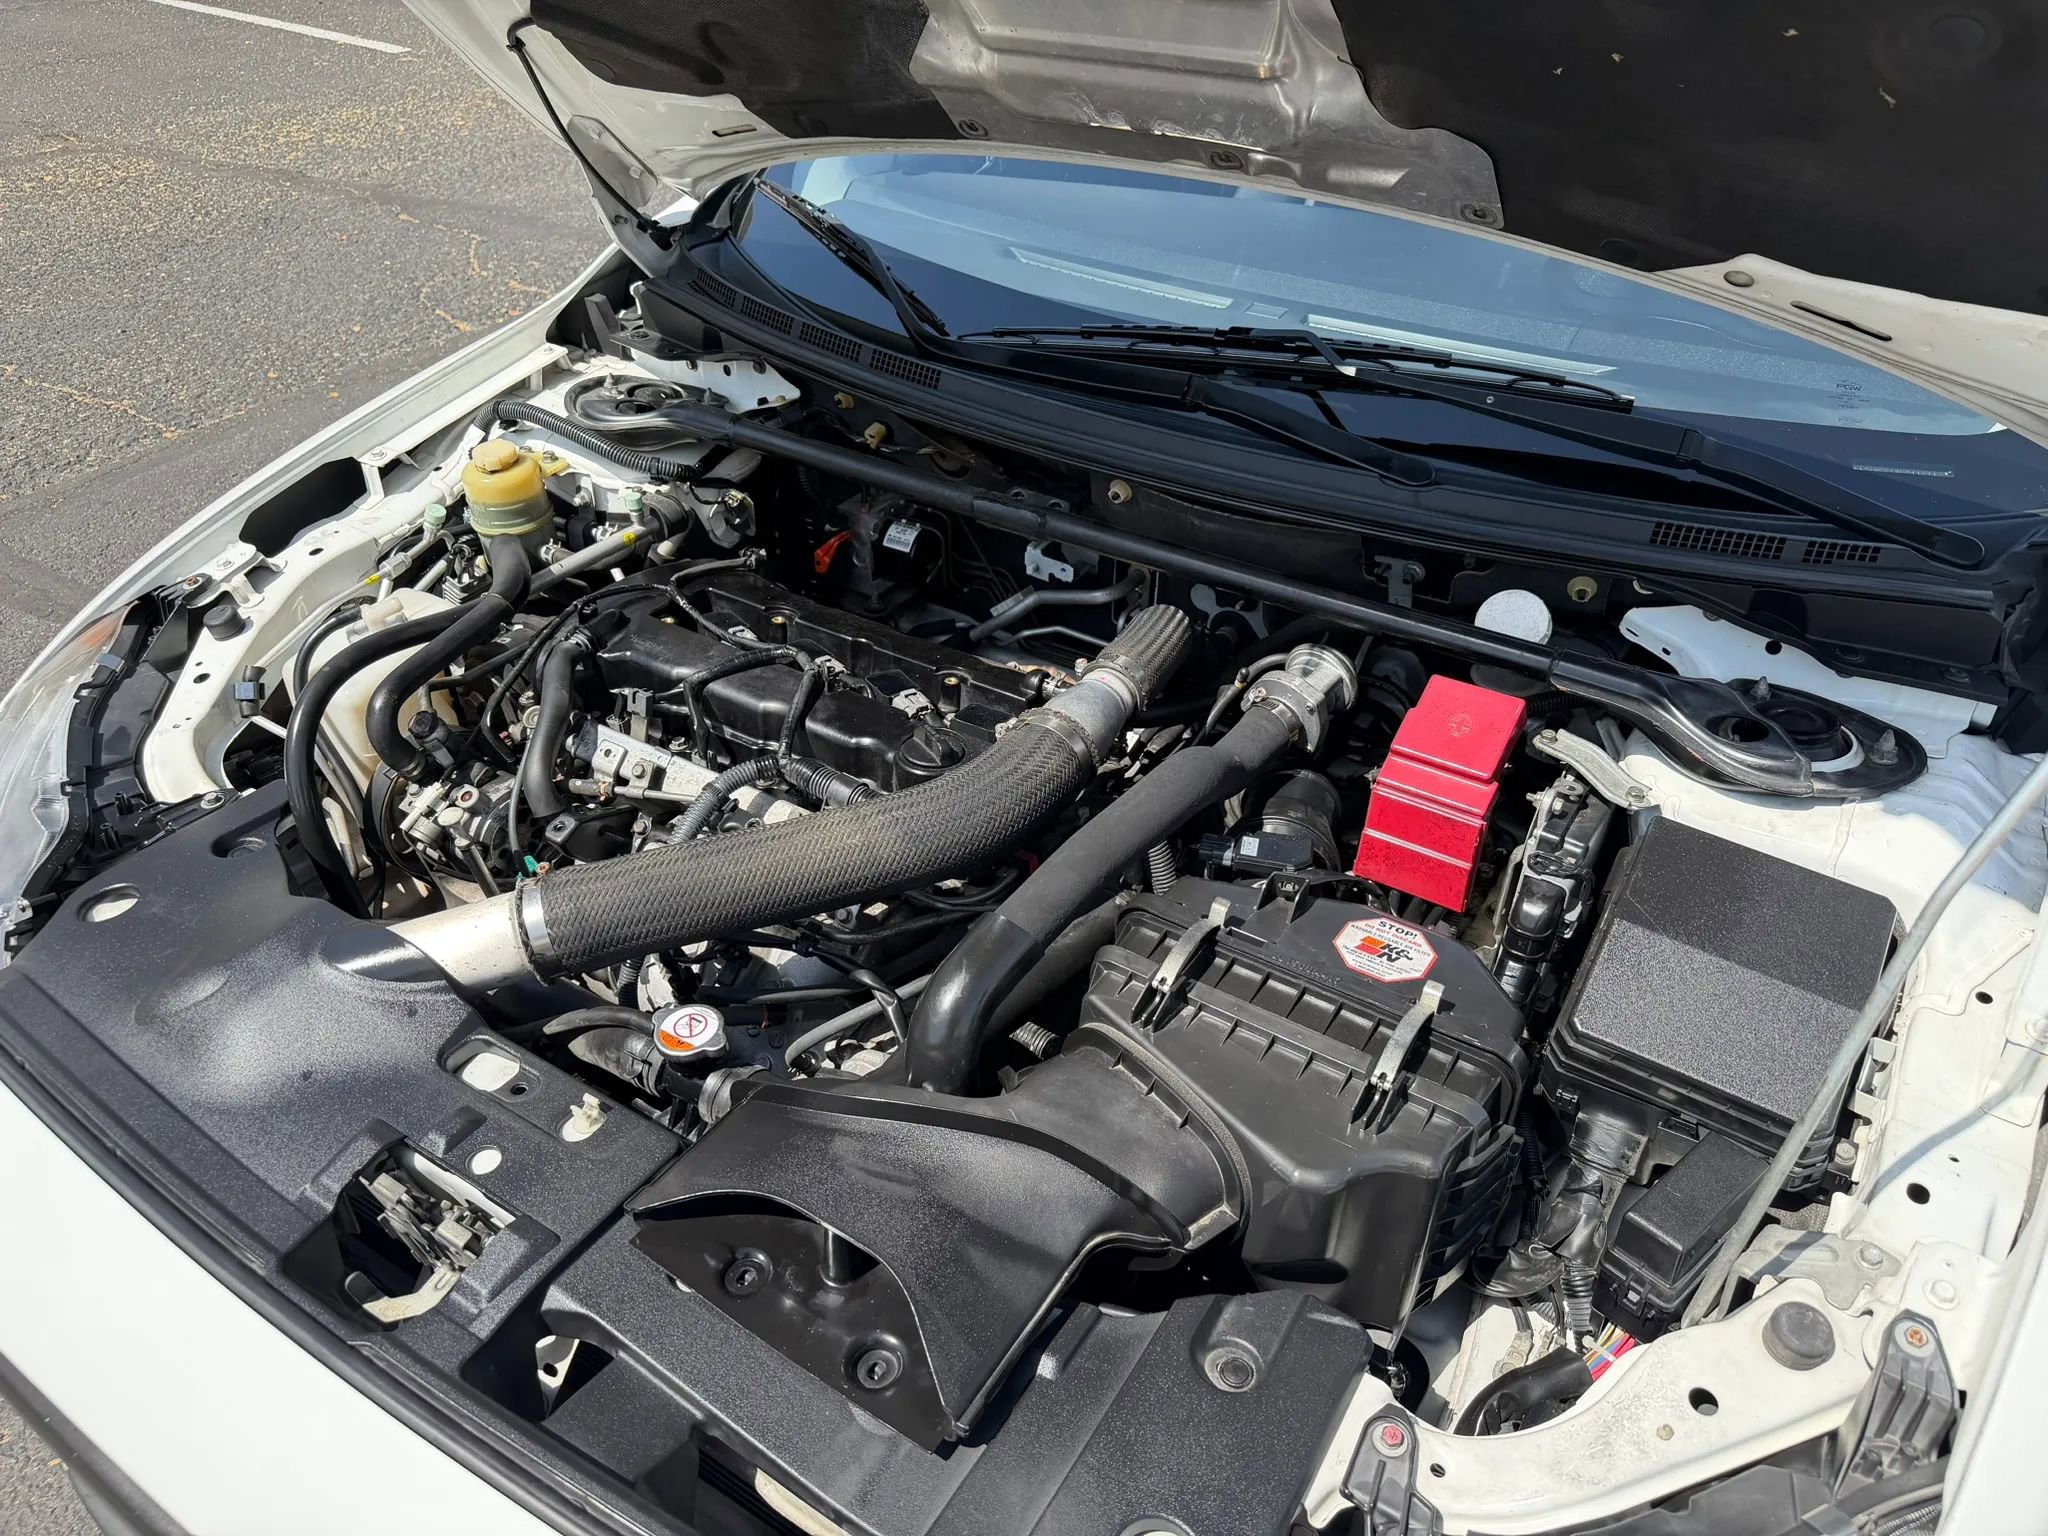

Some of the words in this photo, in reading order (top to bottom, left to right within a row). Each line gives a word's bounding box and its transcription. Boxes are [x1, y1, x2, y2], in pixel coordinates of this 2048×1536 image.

[1836, 383, 1862, 391] PGW
[1364, 922, 1375, 930] DO
[1376, 927, 1391, 937] NOT
[1391, 932, 1422, 948] DISCARD
[1378, 920, 1418, 940] STOP!
